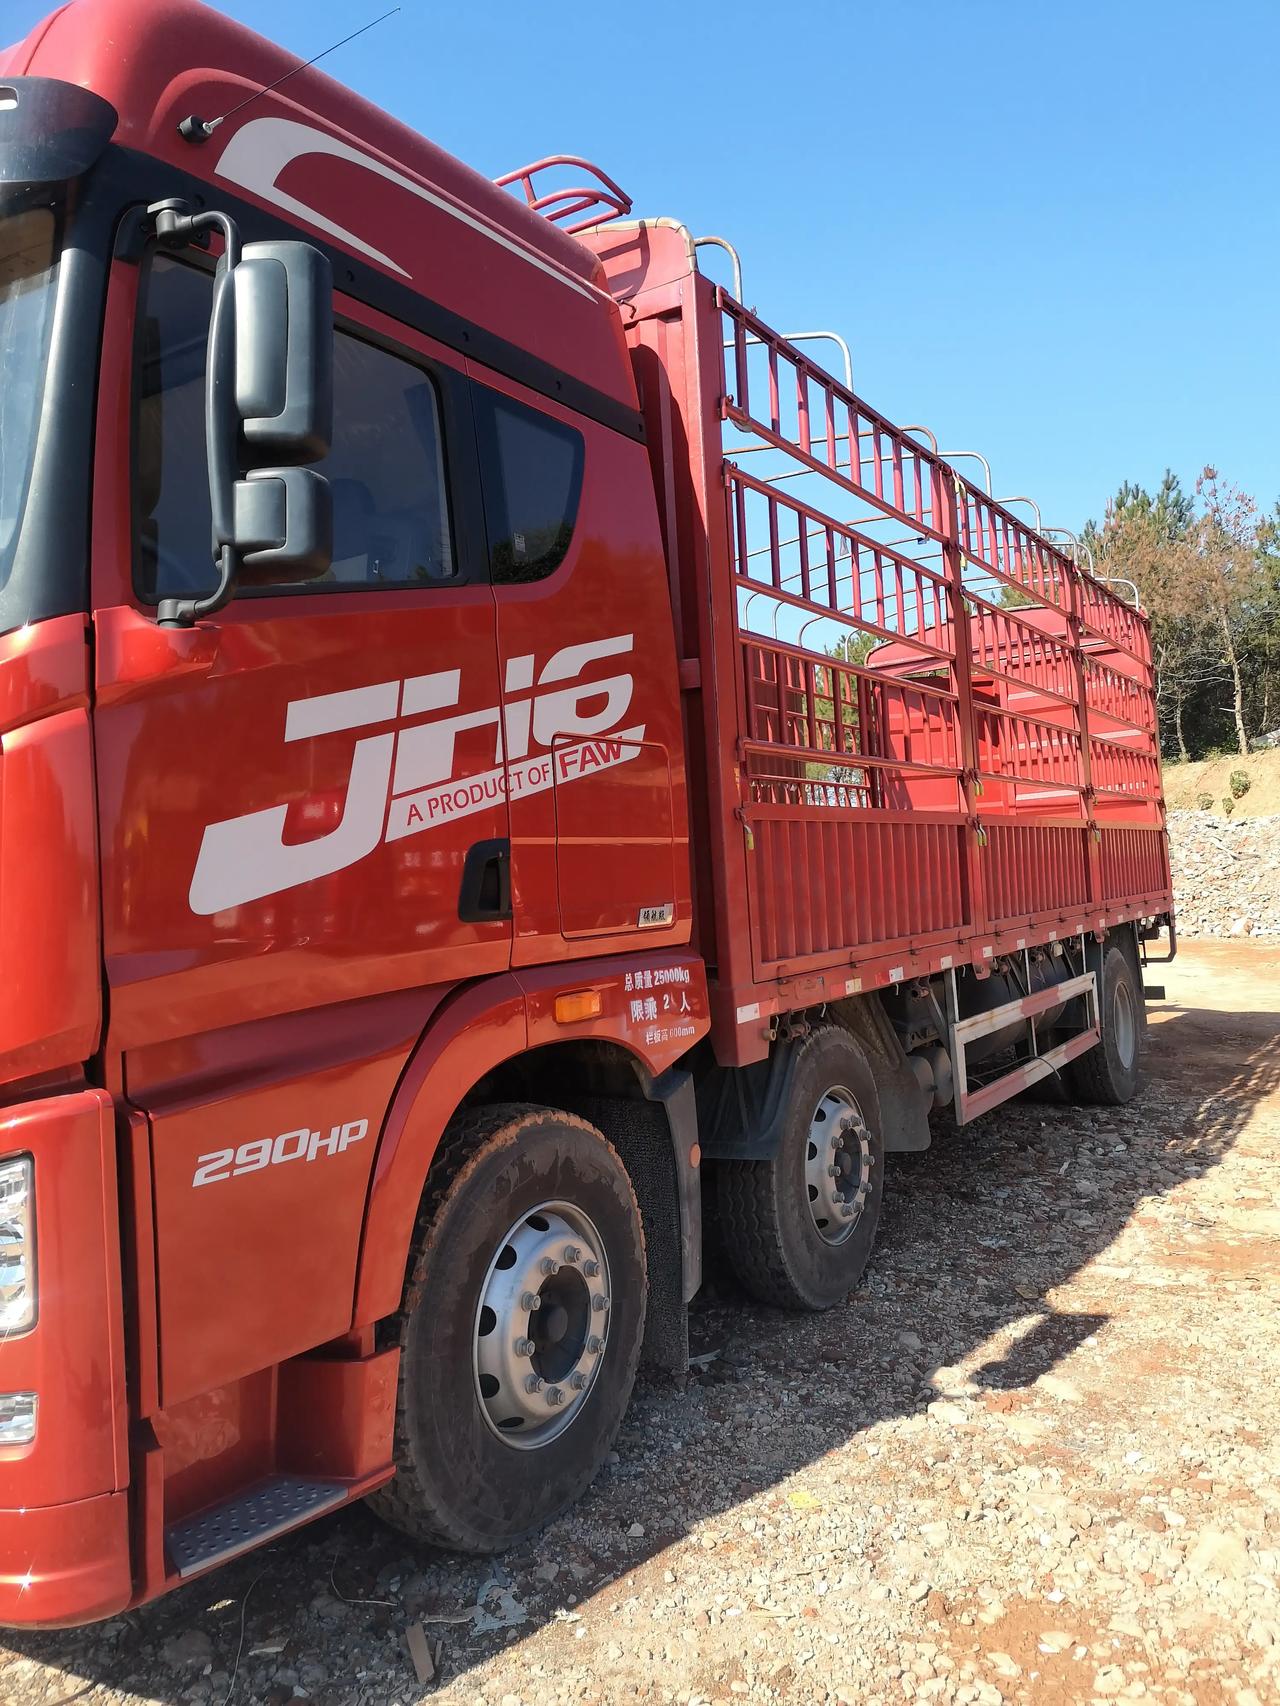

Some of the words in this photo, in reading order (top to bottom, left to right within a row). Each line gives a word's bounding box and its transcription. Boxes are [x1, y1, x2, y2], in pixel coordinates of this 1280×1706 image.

[189, 634, 634, 915] JH6
[406, 803, 424, 826] A
[427, 771, 524, 818] PRODUCT
[528, 763, 551, 785] OF
[558, 736, 623, 778] FAW
[192, 1118, 369, 1188] 290HP
